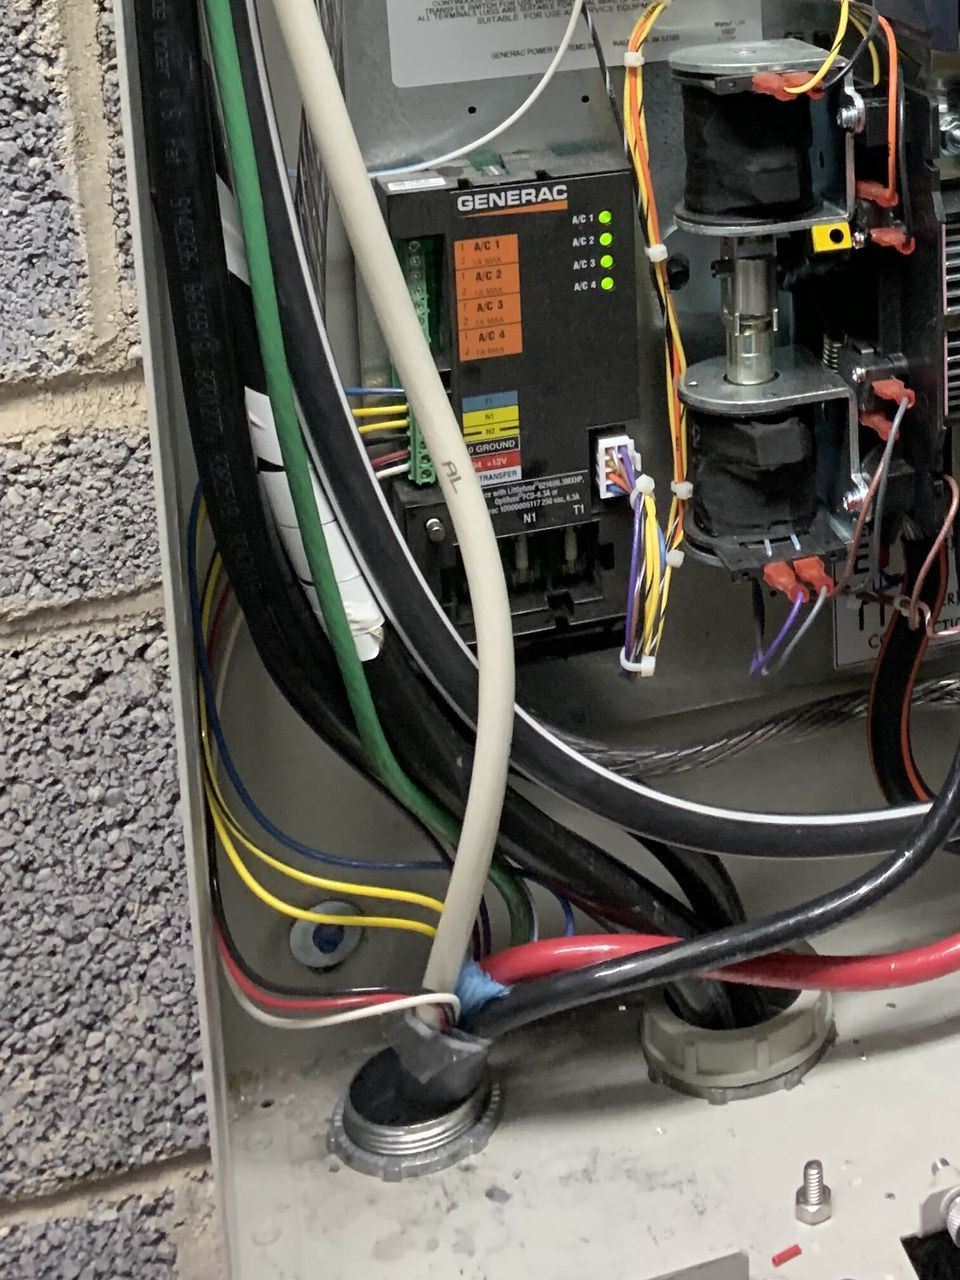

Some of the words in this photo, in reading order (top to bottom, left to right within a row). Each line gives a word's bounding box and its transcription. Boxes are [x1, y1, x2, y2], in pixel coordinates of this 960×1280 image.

[457, 184, 568, 212] GENERAC
[572, 214, 587, 224] A/C
[589, 214, 593, 222] 1
[474, 241, 491, 251] A/C
[495, 240, 500, 250] 1
[572, 237, 587, 247] A/C
[589, 236, 595, 245] 2
[573, 260, 588, 270] A/C
[590, 259, 596, 268] 3
[475, 271, 492, 282] A/C
[496, 270, 502, 279] 2
[574, 282, 589, 291] A/C
[590, 281, 596, 290] 4
[477, 302, 493, 312] A/C
[497, 301, 503, 310] 3
[478, 331, 495, 342] A/C
[499, 330, 505, 339] 4
[485, 413, 494, 421] N1
[476, 439, 516, 453] GROUND
[480, 469, 517, 482] TRANSFER
[573, 504, 585, 515] T1
[523, 513, 536, 524] N1
